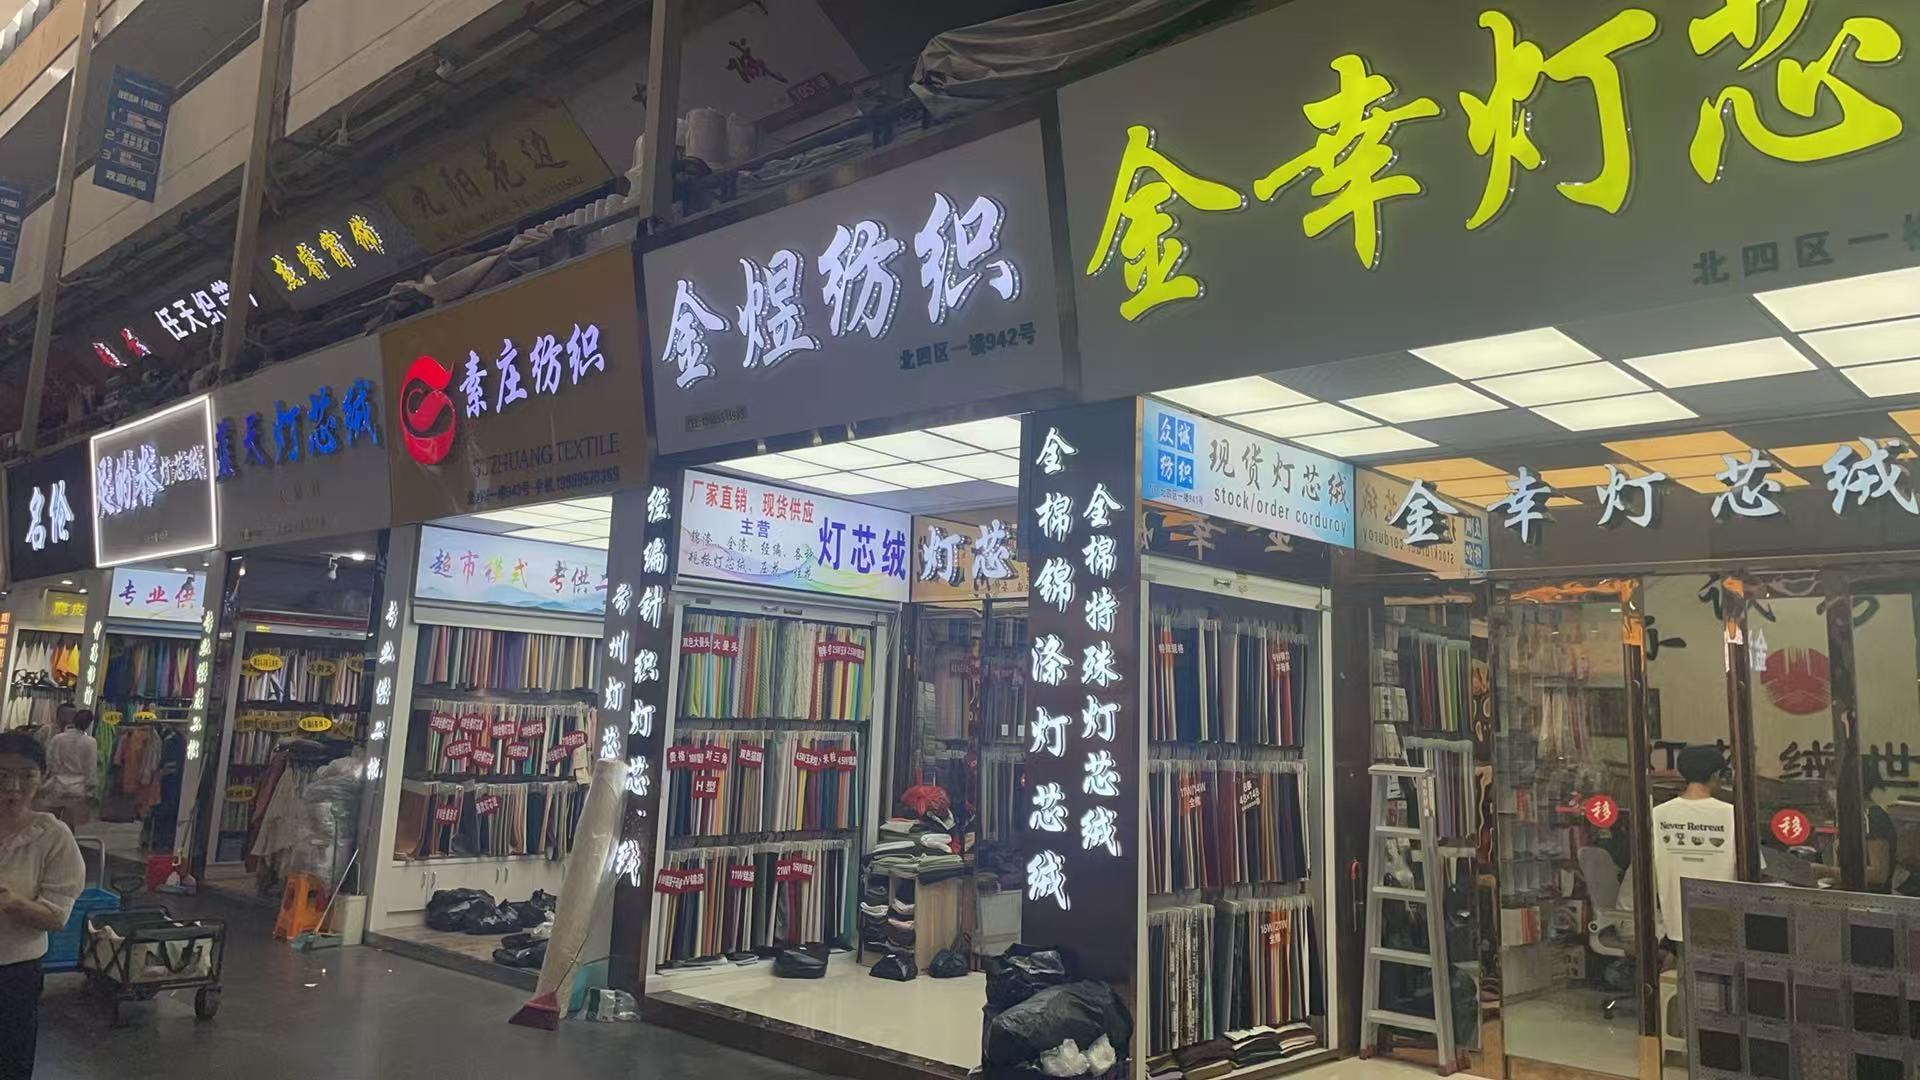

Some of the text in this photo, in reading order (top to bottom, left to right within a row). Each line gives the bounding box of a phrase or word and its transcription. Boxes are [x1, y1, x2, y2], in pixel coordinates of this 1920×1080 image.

[662, 192, 1021, 389] 金煜纺织
[459, 323, 605, 418] 素庄纺织
[556, 432, 619, 462] TEXTILE
[1208, 439, 1349, 512] 现货灯芯绒
[1214, 486, 1347, 537] stock/order corduroy
[1389, 437, 1919, 546] 金幸灯芯绒
[740, 518, 770, 538] 主营
[817, 517, 906, 581] 灯芯绒
[1081, 483, 1123, 857] 全棉特殊灯芯绒
[1660, 821, 1725, 833] Never Retreat
[1778, 816, 1803, 837] 移
